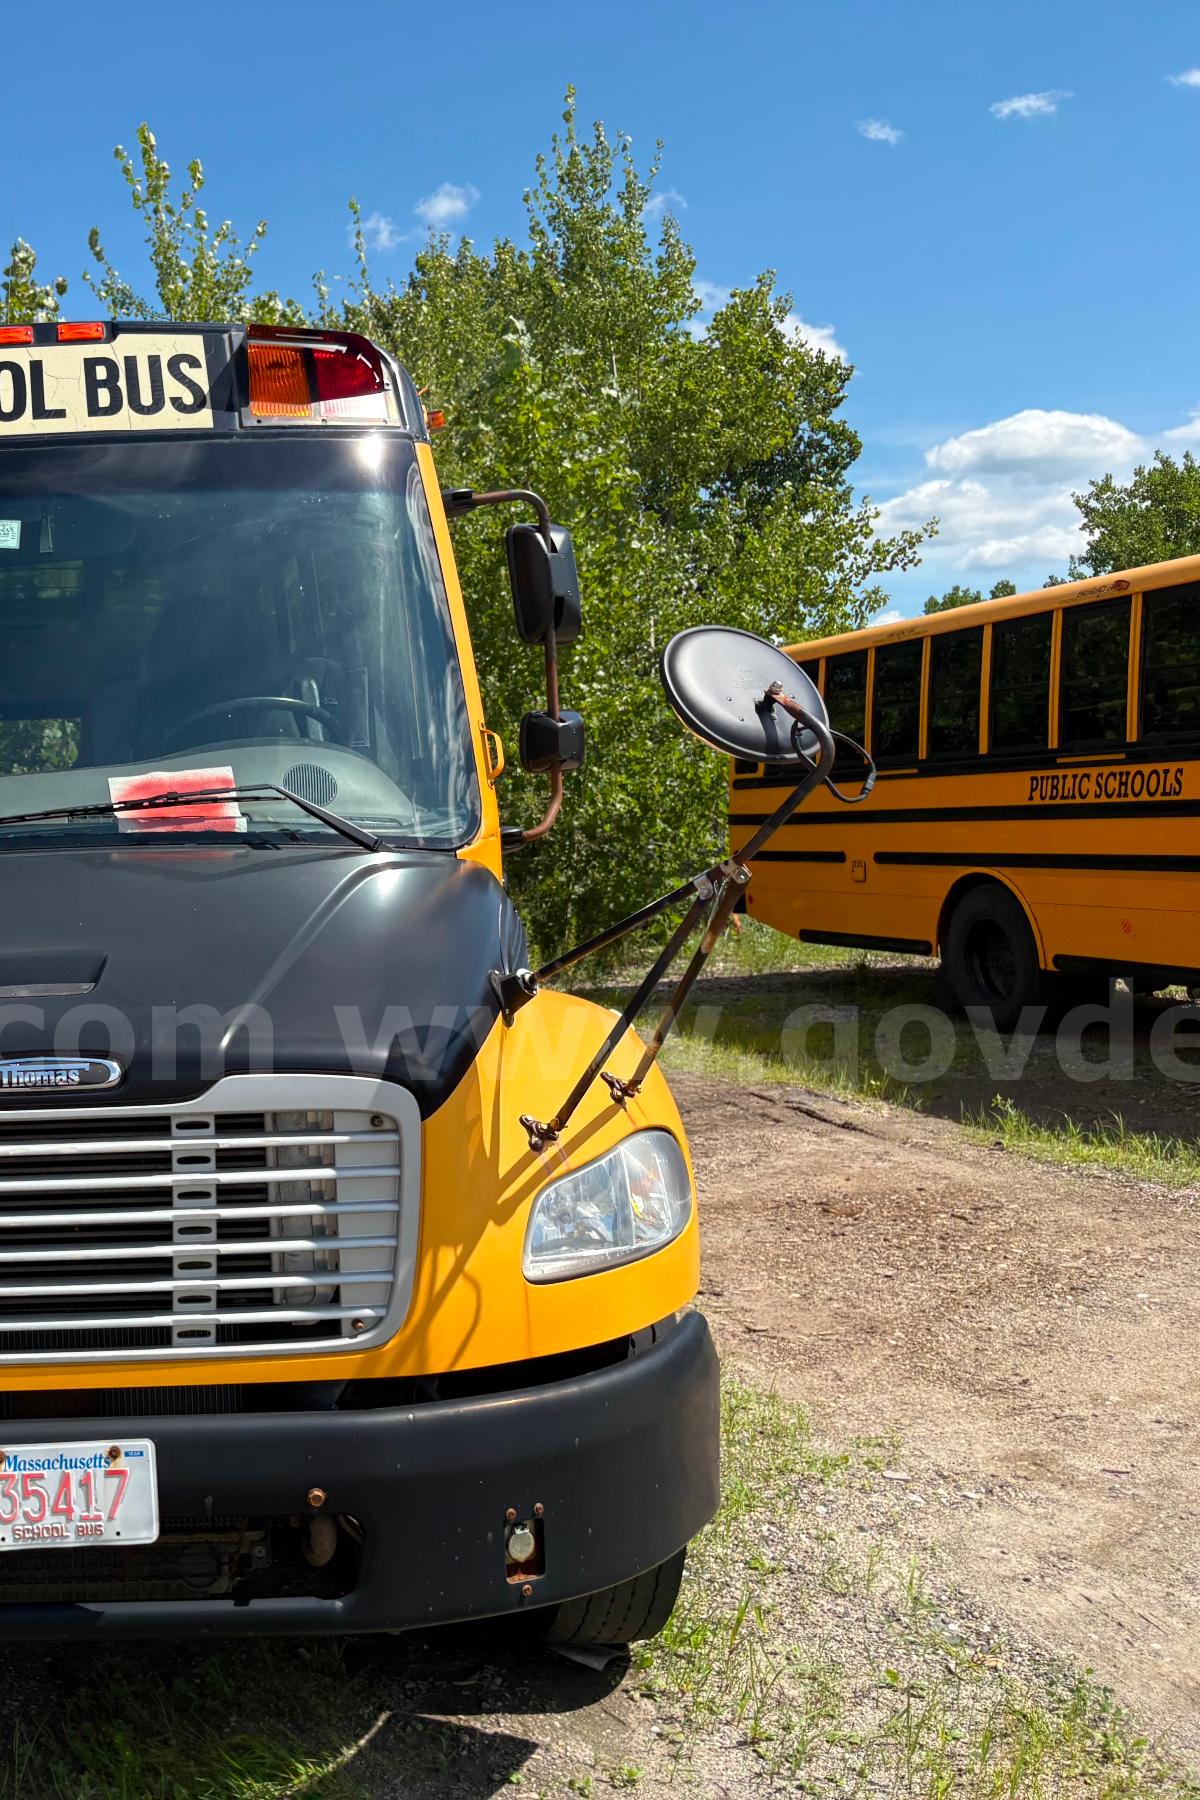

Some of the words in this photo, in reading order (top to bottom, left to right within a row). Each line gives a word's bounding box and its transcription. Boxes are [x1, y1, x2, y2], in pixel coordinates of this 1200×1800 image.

[83, 353, 208, 418] BUS
[1028, 773, 1091, 801] PUBLIC
[1094, 768, 1184, 799] SCHOOLS
[3, 1452, 111, 1472] Massachusetts
[12, 1524, 71, 1542] SCHOOL
[75, 1522, 105, 1538] BUS
